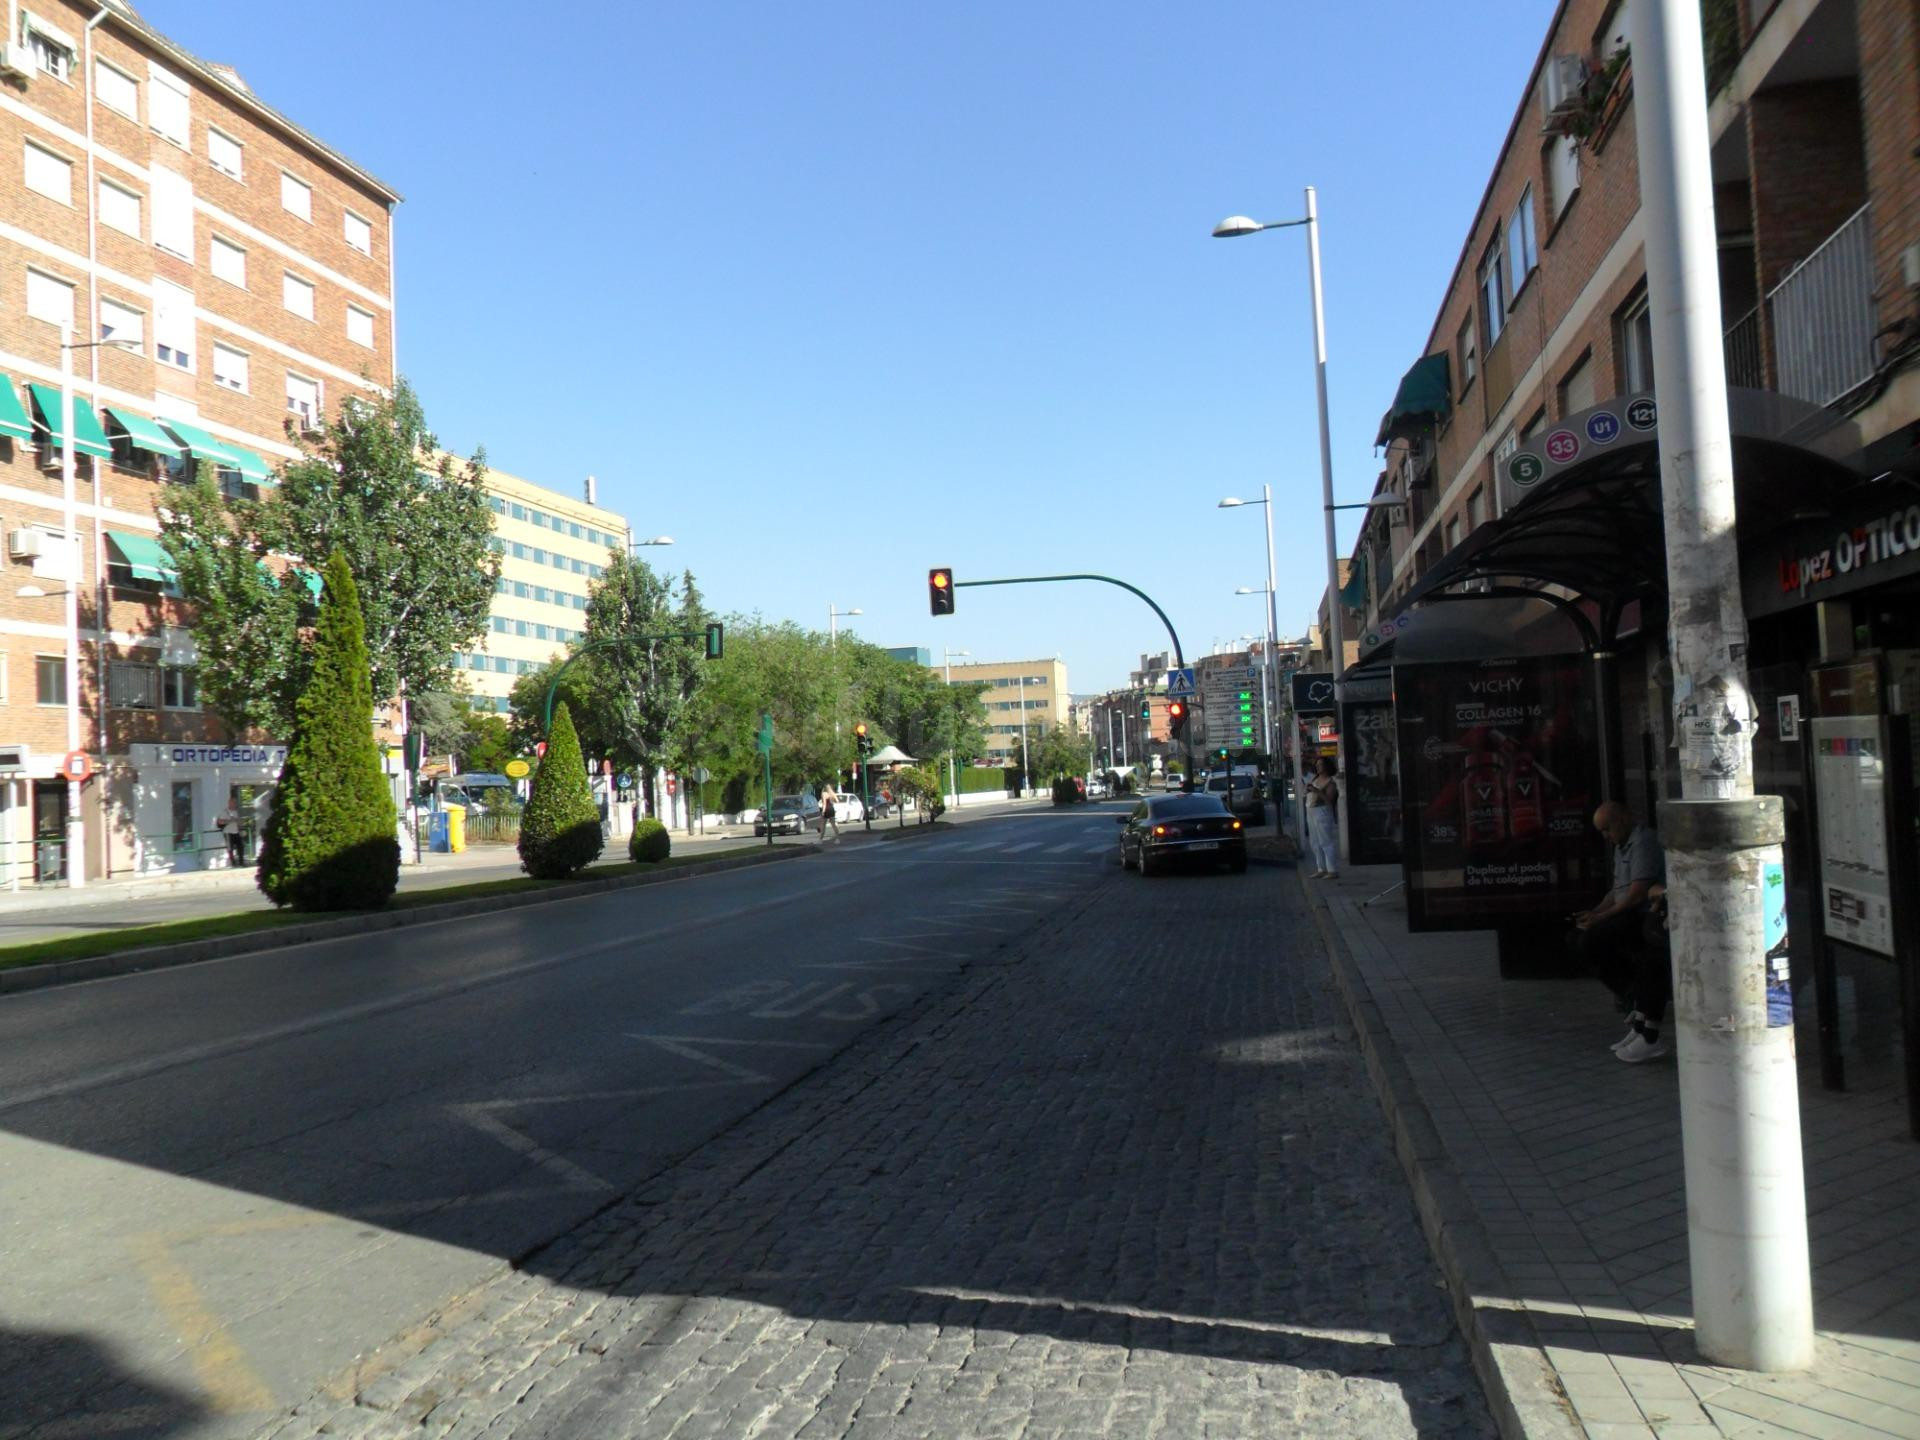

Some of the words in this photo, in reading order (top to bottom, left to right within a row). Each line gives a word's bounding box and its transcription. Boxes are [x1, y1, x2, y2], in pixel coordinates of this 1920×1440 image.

[1520, 462, 1532, 477] 5
[1551, 439, 1575, 455] 33
[1594, 421, 1612, 434] U1
[1631, 408, 1656, 422] 121
[1468, 678, 1524, 694] VICHY
[1456, 706, 1523, 720] COLLAGEN
[1527, 705, 1542, 716] 16
[172, 748, 268, 762] ORTOPEDIA
[1466, 865, 1506, 877] Duplica
[1508, 862, 1518, 873] el
[1520, 861, 1552, 875] poder
[1467, 875, 1481, 885] de
